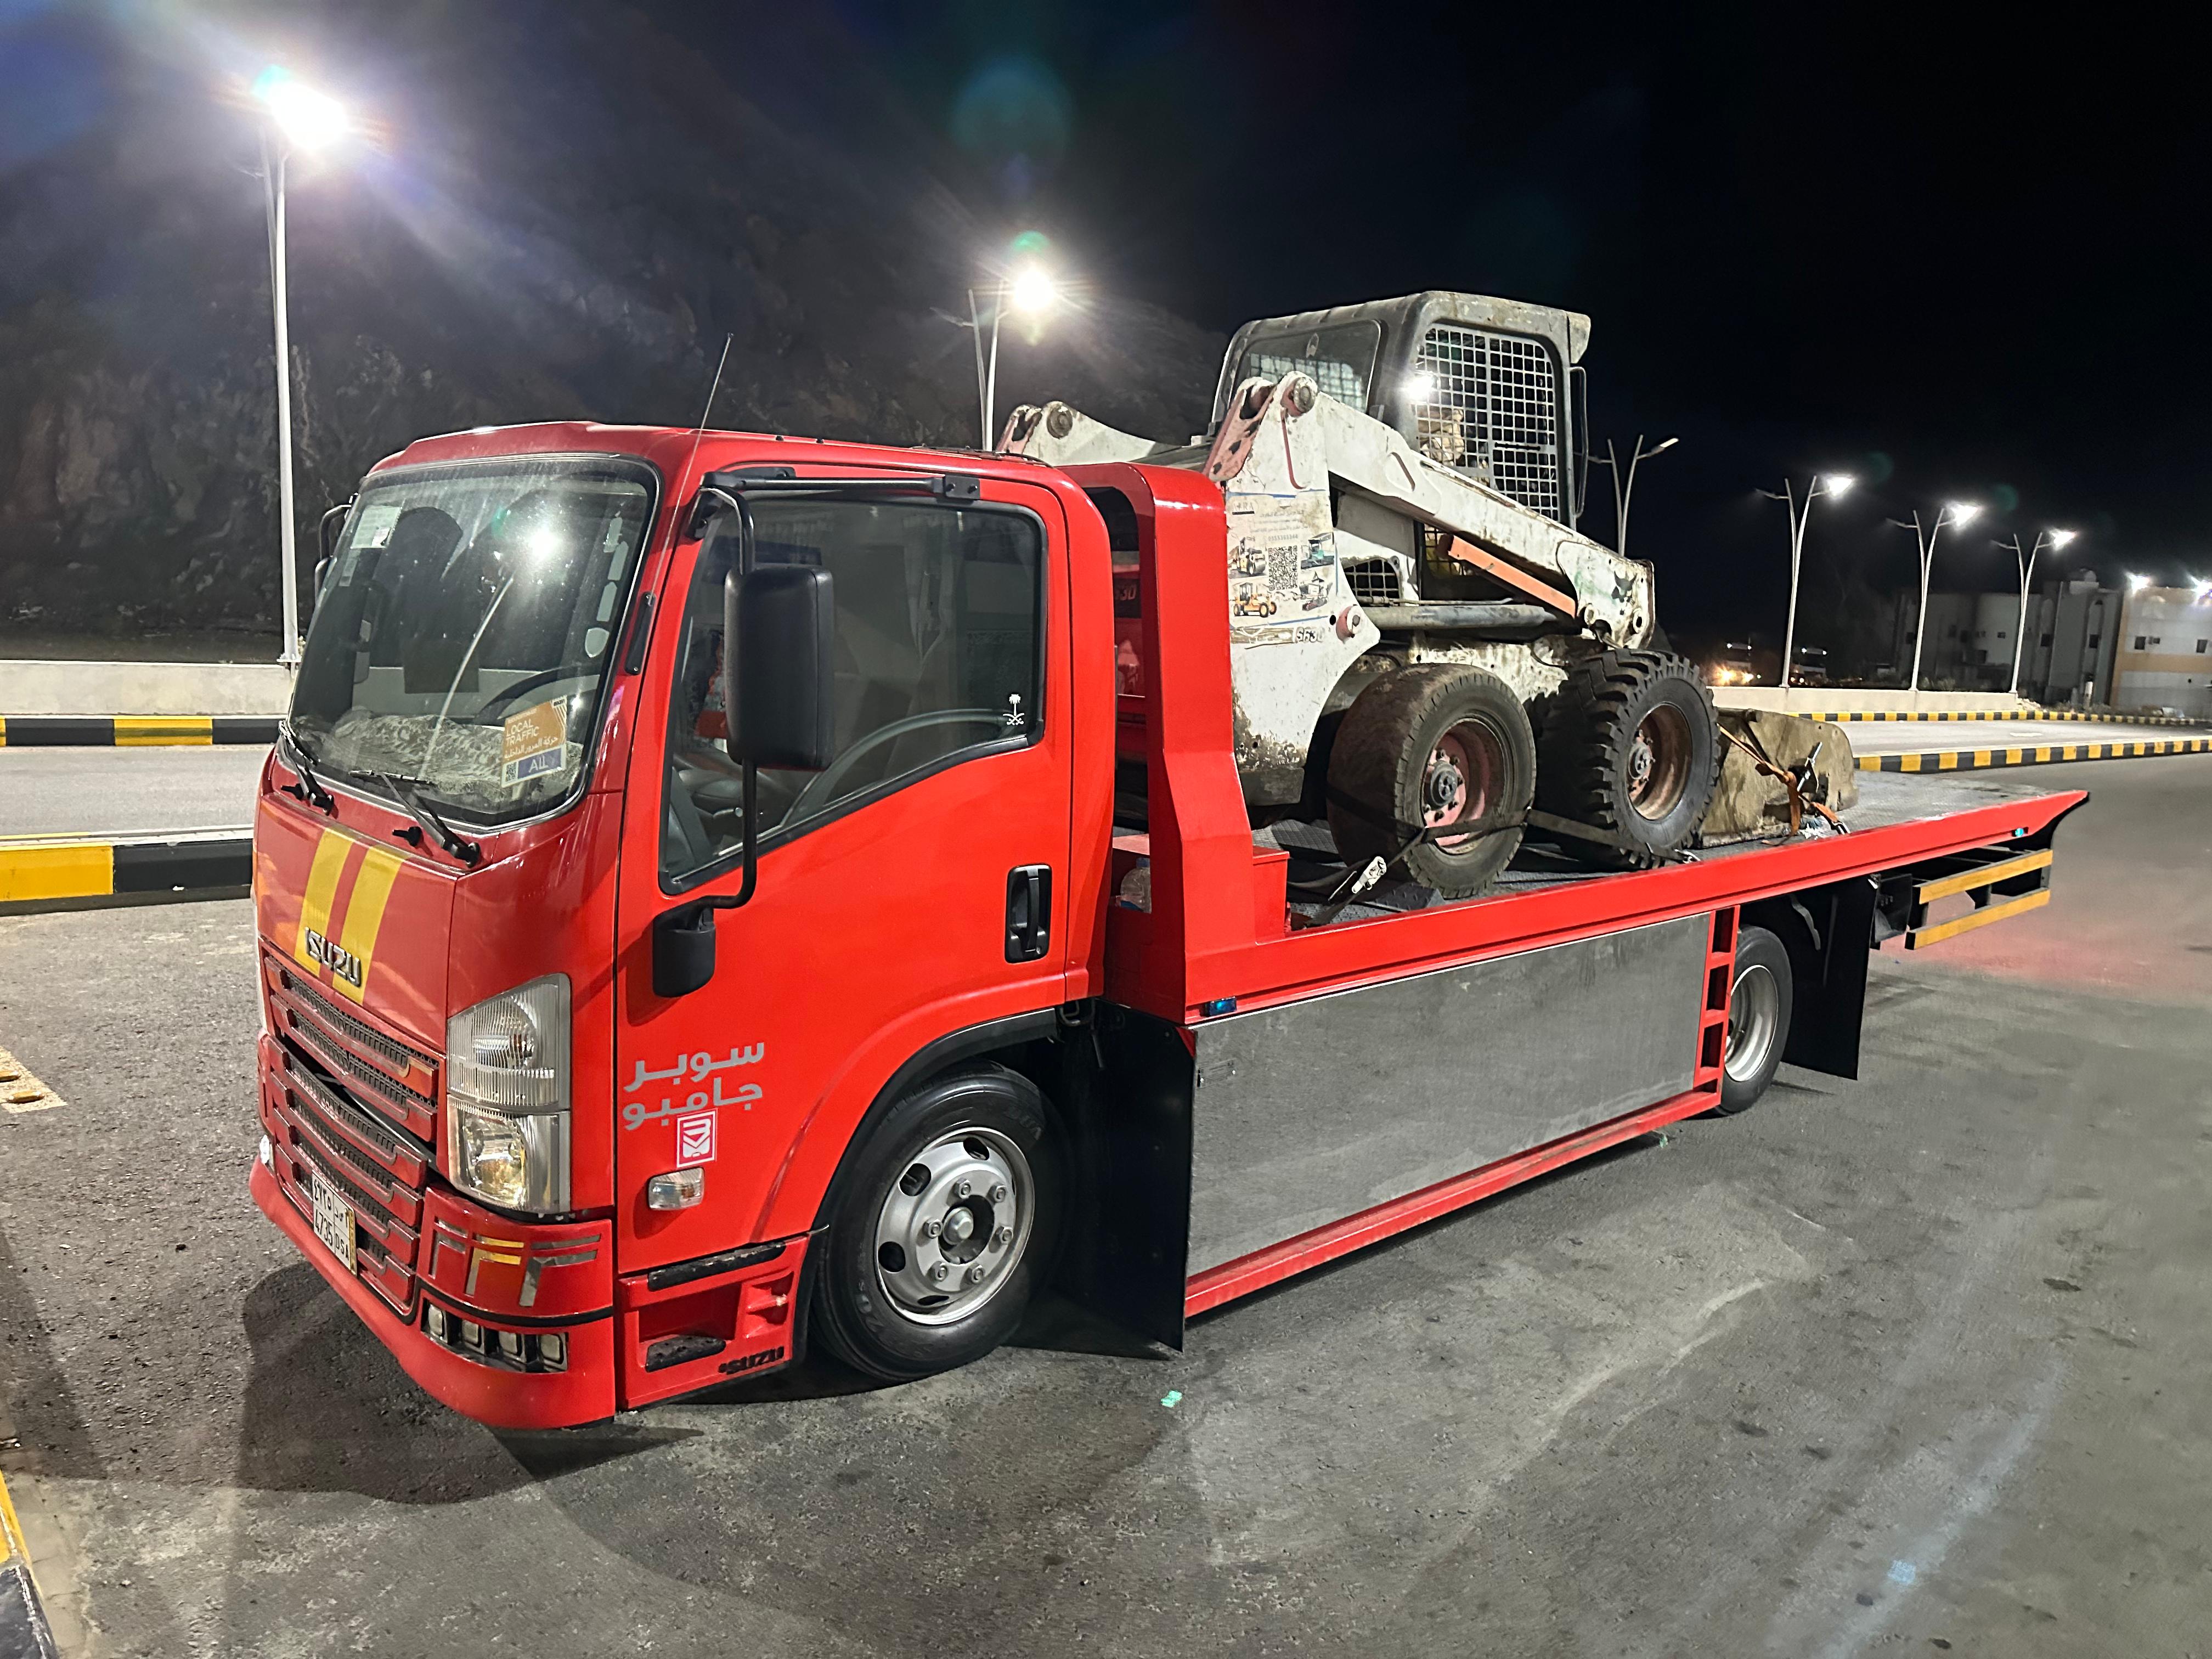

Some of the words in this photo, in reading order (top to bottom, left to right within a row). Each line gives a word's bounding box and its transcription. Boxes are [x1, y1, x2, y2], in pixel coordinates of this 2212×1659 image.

[505, 726, 540, 747] TRAFFIC
[506, 718, 534, 737] LOCAL
[528, 755, 549, 773] ALL
[304, 927, 362, 988] ISUZU
[623, 1041, 765, 1093] سوبر
[622, 1077, 763, 1131] جامبو
[314, 1209, 333, 1246] 4735
[335, 1233, 349, 1261] DSA
